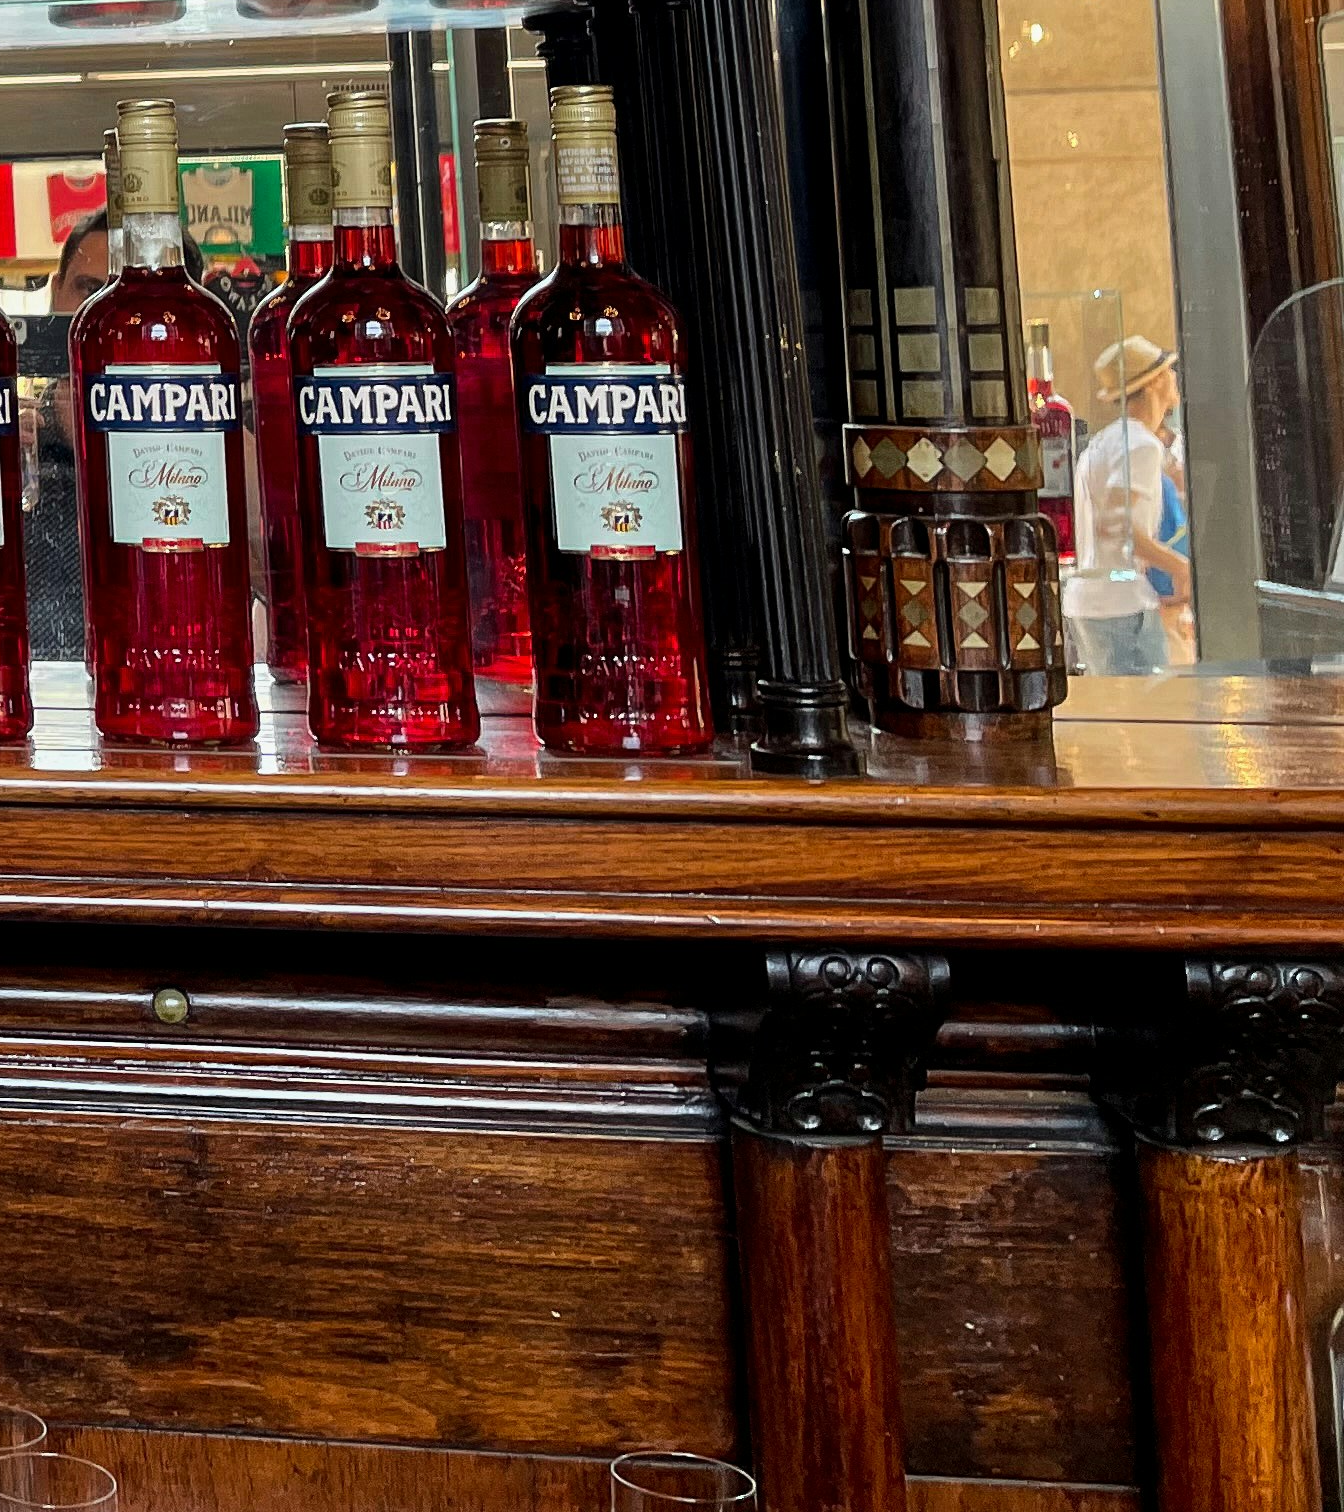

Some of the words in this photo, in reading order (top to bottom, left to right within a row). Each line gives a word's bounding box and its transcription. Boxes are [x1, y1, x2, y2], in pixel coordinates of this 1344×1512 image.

[90, 383, 236, 422] CAMPARI
[299, 384, 451, 424] CAMPARI
[529, 384, 686, 424] CAMPARI
